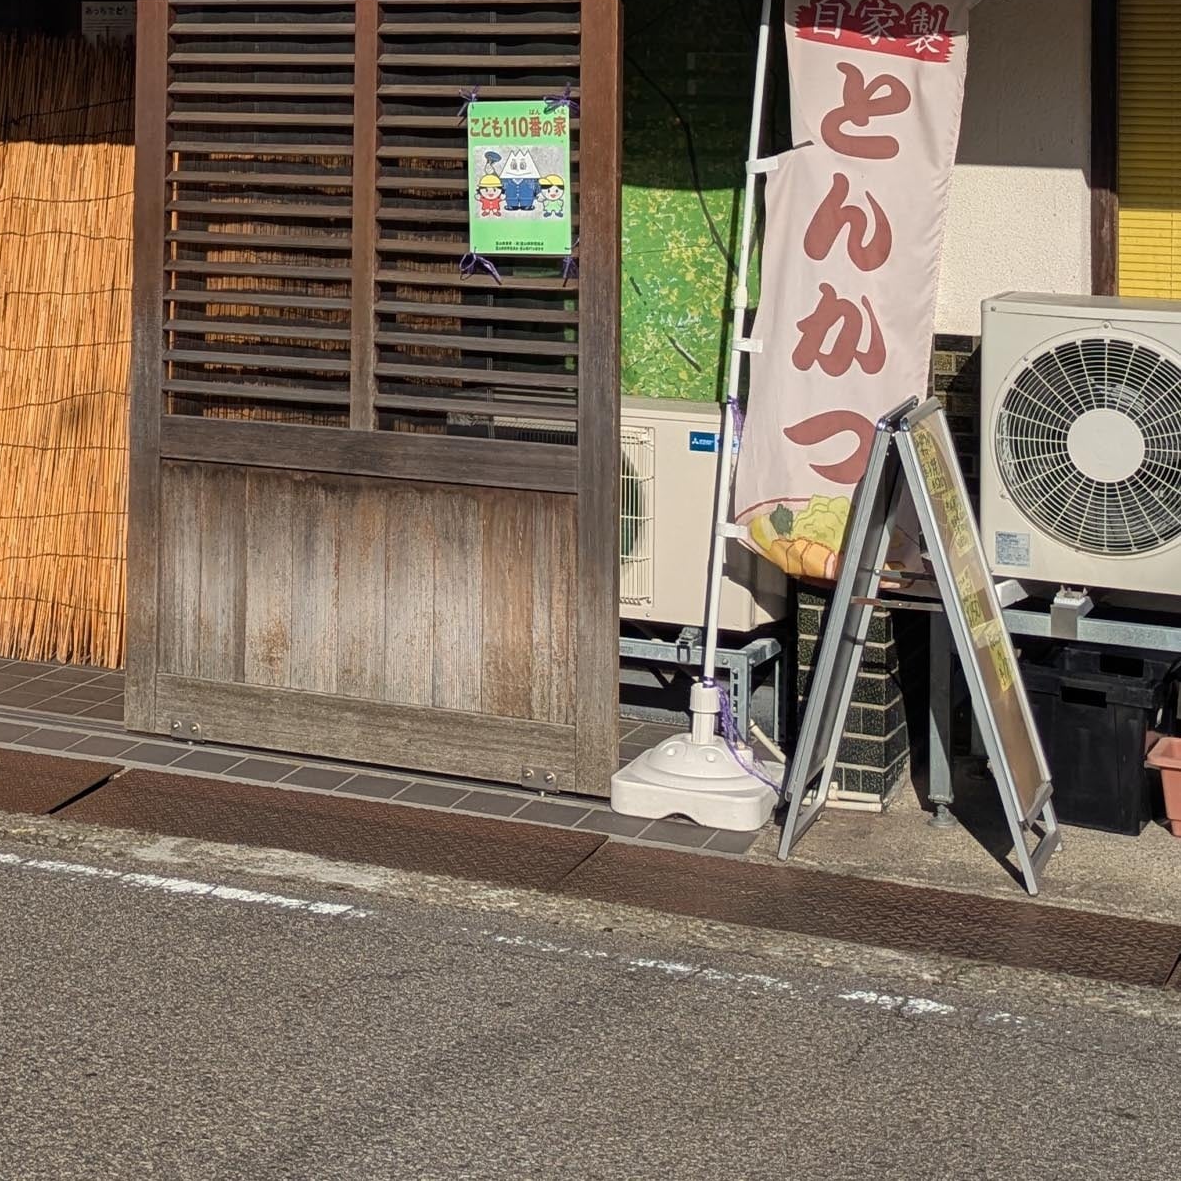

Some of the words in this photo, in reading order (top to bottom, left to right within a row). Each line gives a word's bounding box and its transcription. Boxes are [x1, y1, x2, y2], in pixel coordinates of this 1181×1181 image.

[470, 116, 566, 138] こども110番の家
[784, 61, 912, 485] とんかつ
